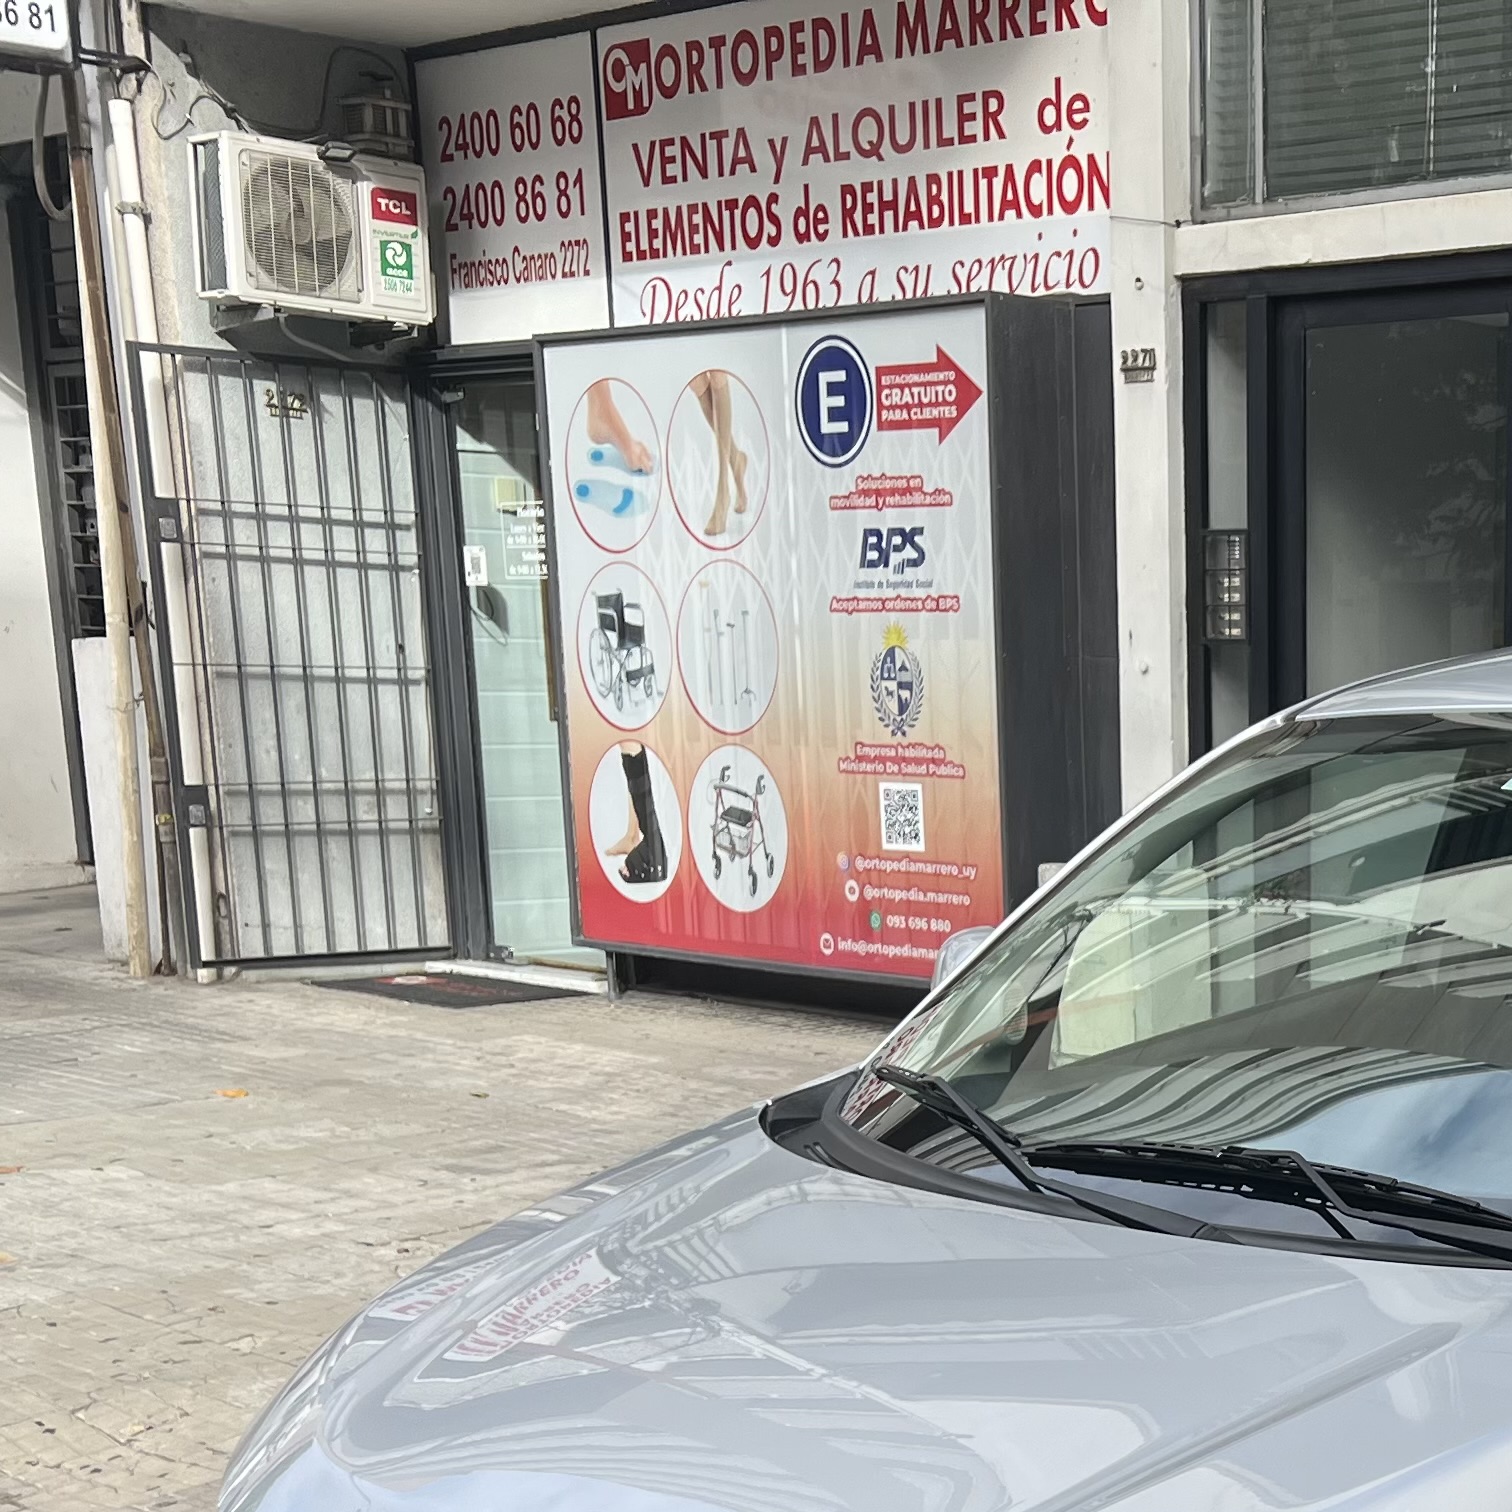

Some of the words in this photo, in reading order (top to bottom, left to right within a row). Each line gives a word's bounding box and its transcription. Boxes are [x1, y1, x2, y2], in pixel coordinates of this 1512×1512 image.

[0, 0, 19, 26] 6
[28, 1, 56, 32] 81
[654, 8, 884, 100] ORTOPEDIA
[438, 108, 501, 163] 2400
[509, 102, 541, 153] 60
[550, 95, 583, 147] 68
[632, 126, 757, 188] VENTA
[767, 135, 788, 184] y
[801, 90, 1006, 167] ALQUILER
[1037, 77, 1091, 135] de
[376, 197, 412, 216] TCL
[443, 179, 505, 232] 2400
[514, 174, 547, 224] 86
[555, 168, 586, 219] 81
[619, 193, 782, 263] ELEMENTOS
[793, 184, 829, 244] de
[841, 136, 1111, 239] REHABILITACIÓN
[450, 249, 509, 291] Francisco
[512, 245, 557, 284] Canaro
[560, 238, 590, 279] 2272
[640, 259, 743, 325] Desde
[760, 257, 842, 315] 1963
[857, 266, 880, 305] a
[891, 263, 934, 301] su
[947, 228, 1100, 295] servicio
[881, 370, 955, 385] ESTACIONAMIENTO
[817, 369, 849, 434] E
[881, 385, 957, 406] GRATUITO
[881, 407, 909, 422] PARA
[910, 405, 957, 420] CLIENTES
[857, 475, 907, 490] Soluciones
[909, 477, 922, 489] en
[831, 492, 876, 508] movilidad
[876, 496, 885, 511] y
[885, 490, 952, 507] rehabilitación
[859, 526, 926, 572] BPS
[831, 597, 883, 614] Aceptamos
[924, 596, 937, 610] de
[938, 597, 959, 610] BPS
[856, 743, 896, 759] Empresa
[897, 743, 945, 759] habilitada
[839, 759, 885, 773] Ministerio
[886, 761, 899, 774] De
[900, 761, 927, 775] Salud
[855, 856, 976, 880] @ortopediamarrero_uy
[863, 884, 971, 906] @ortopedia.marrero
[886, 914, 906, 929] 093
[908, 916, 928, 931] 696
